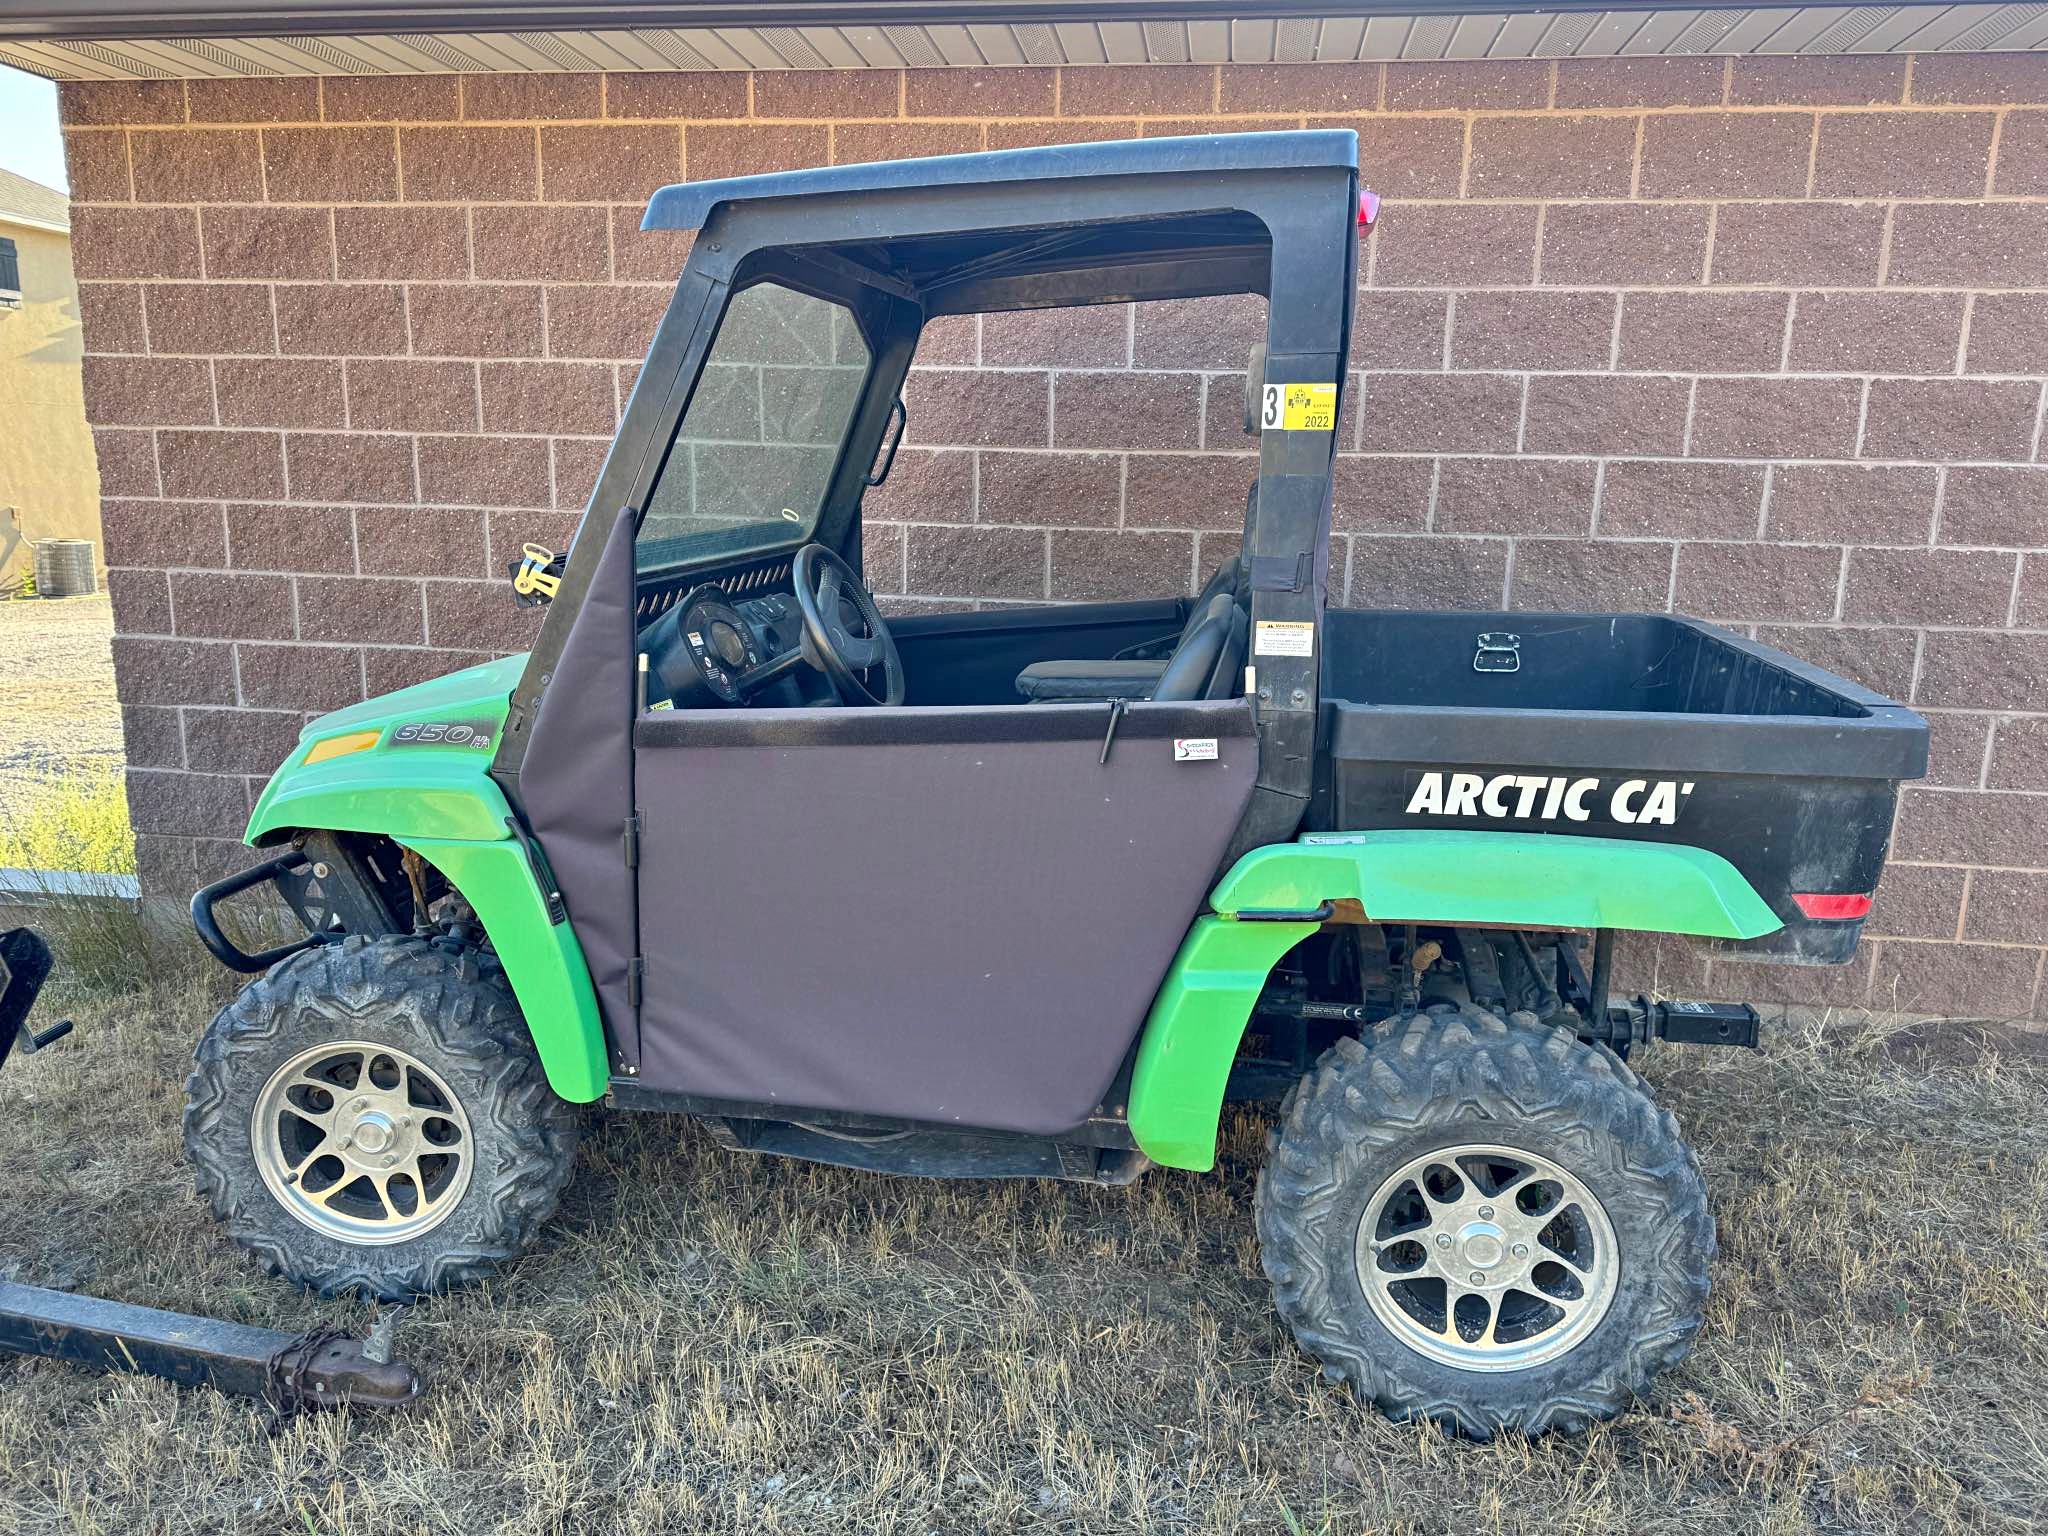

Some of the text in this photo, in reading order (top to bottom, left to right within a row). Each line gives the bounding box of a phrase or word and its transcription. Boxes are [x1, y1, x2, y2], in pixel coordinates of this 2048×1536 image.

[1264, 386, 1278, 426] 3
[1304, 415, 1329, 428] 2022
[394, 723, 474, 744] 650
[1405, 772, 1695, 825] ARCTIC CA
